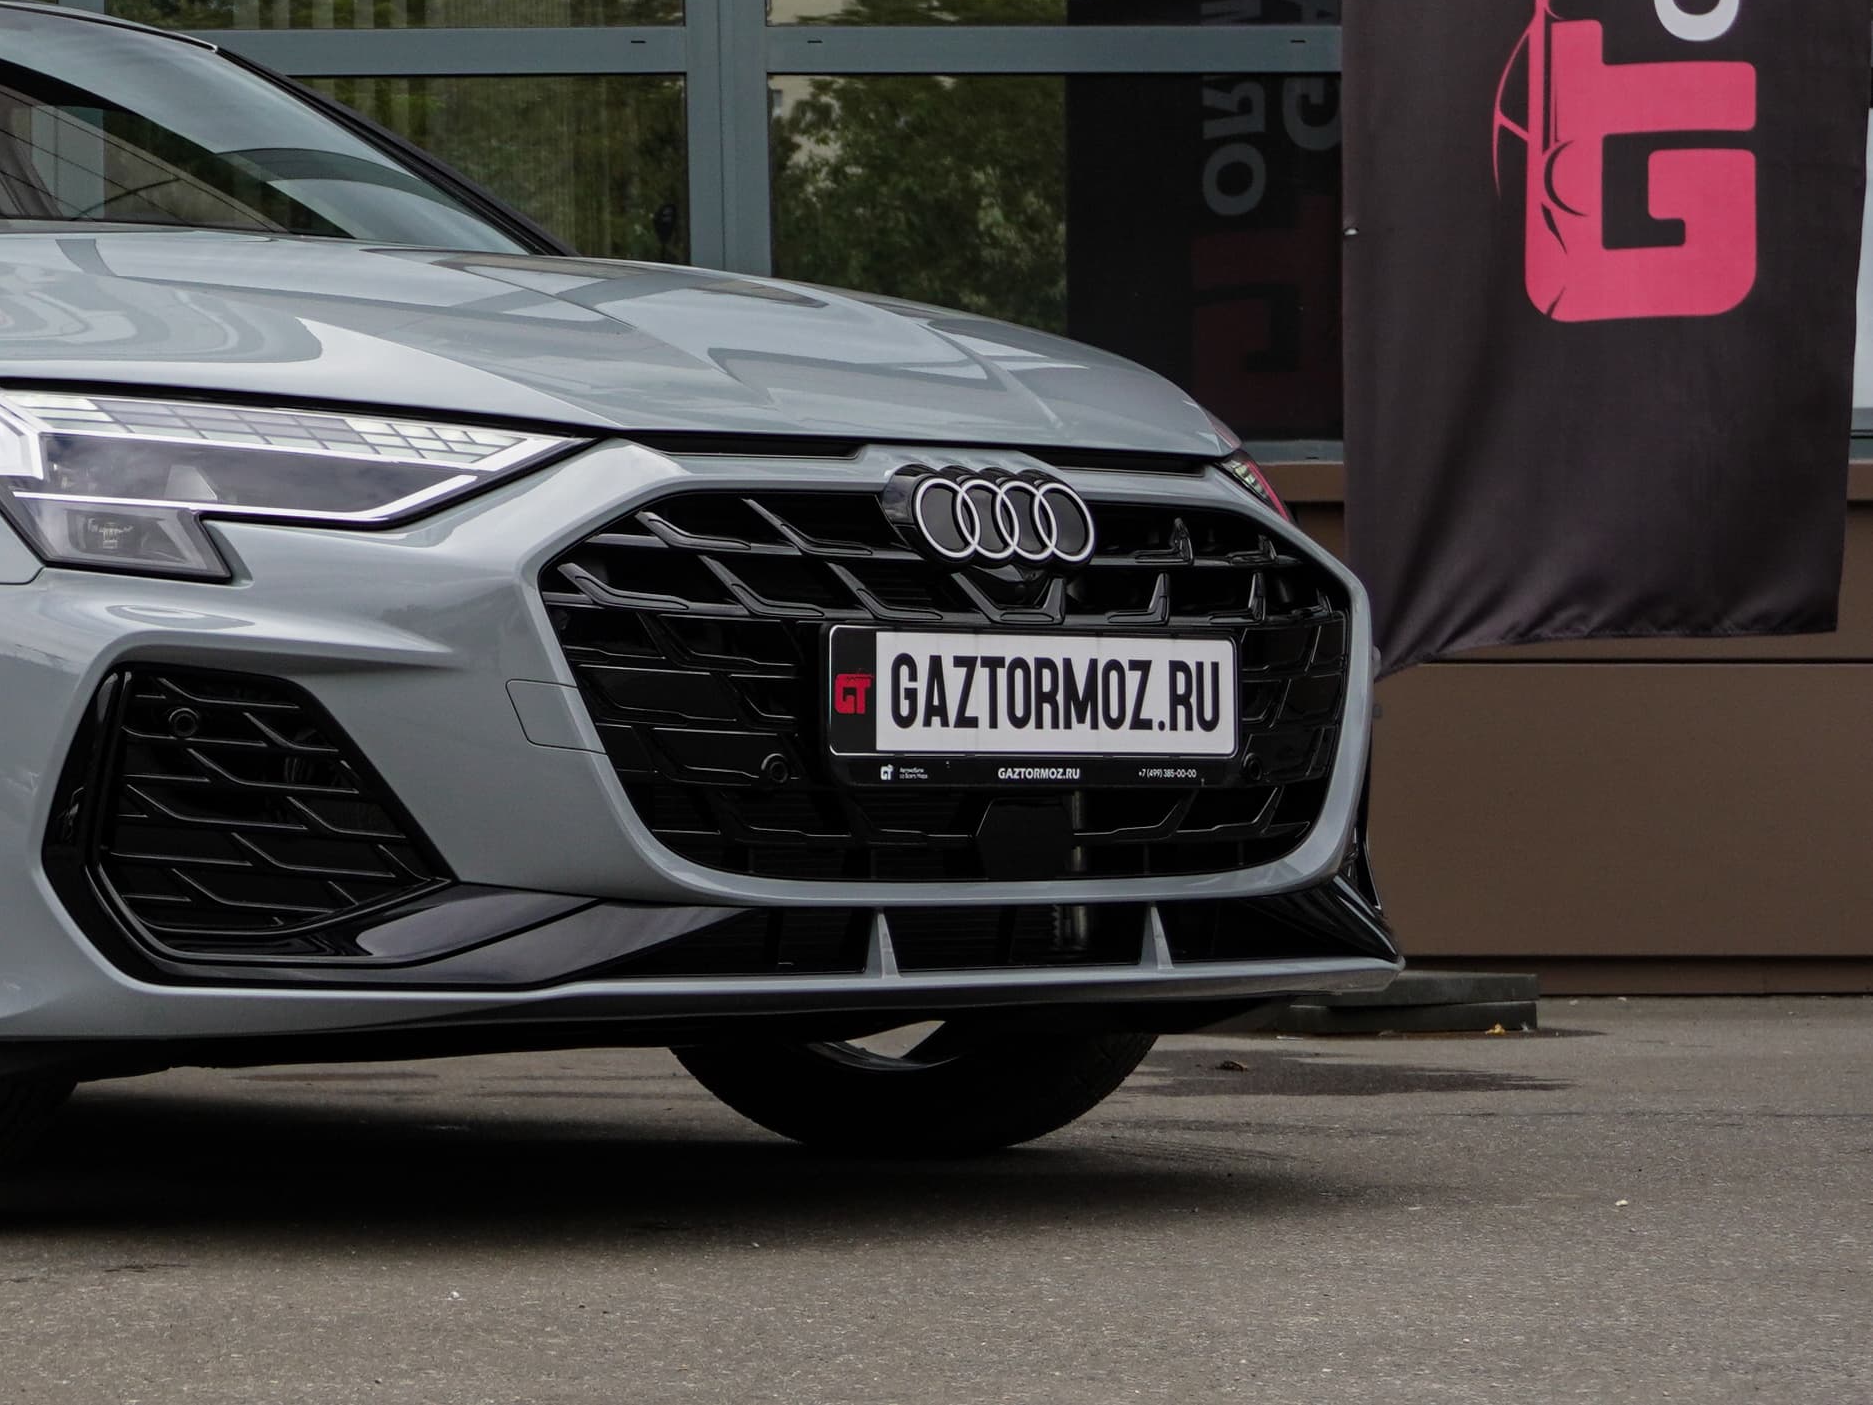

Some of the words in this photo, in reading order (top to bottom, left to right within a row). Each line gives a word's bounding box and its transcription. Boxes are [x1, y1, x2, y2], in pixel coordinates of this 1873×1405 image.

[1519, 16, 1757, 323] GT
[835, 673, 872, 714] GT
[891, 652, 1220, 732] GAZTORMOZ.RU
[998, 768, 1080, 779] GAZTORMOZ.RU
